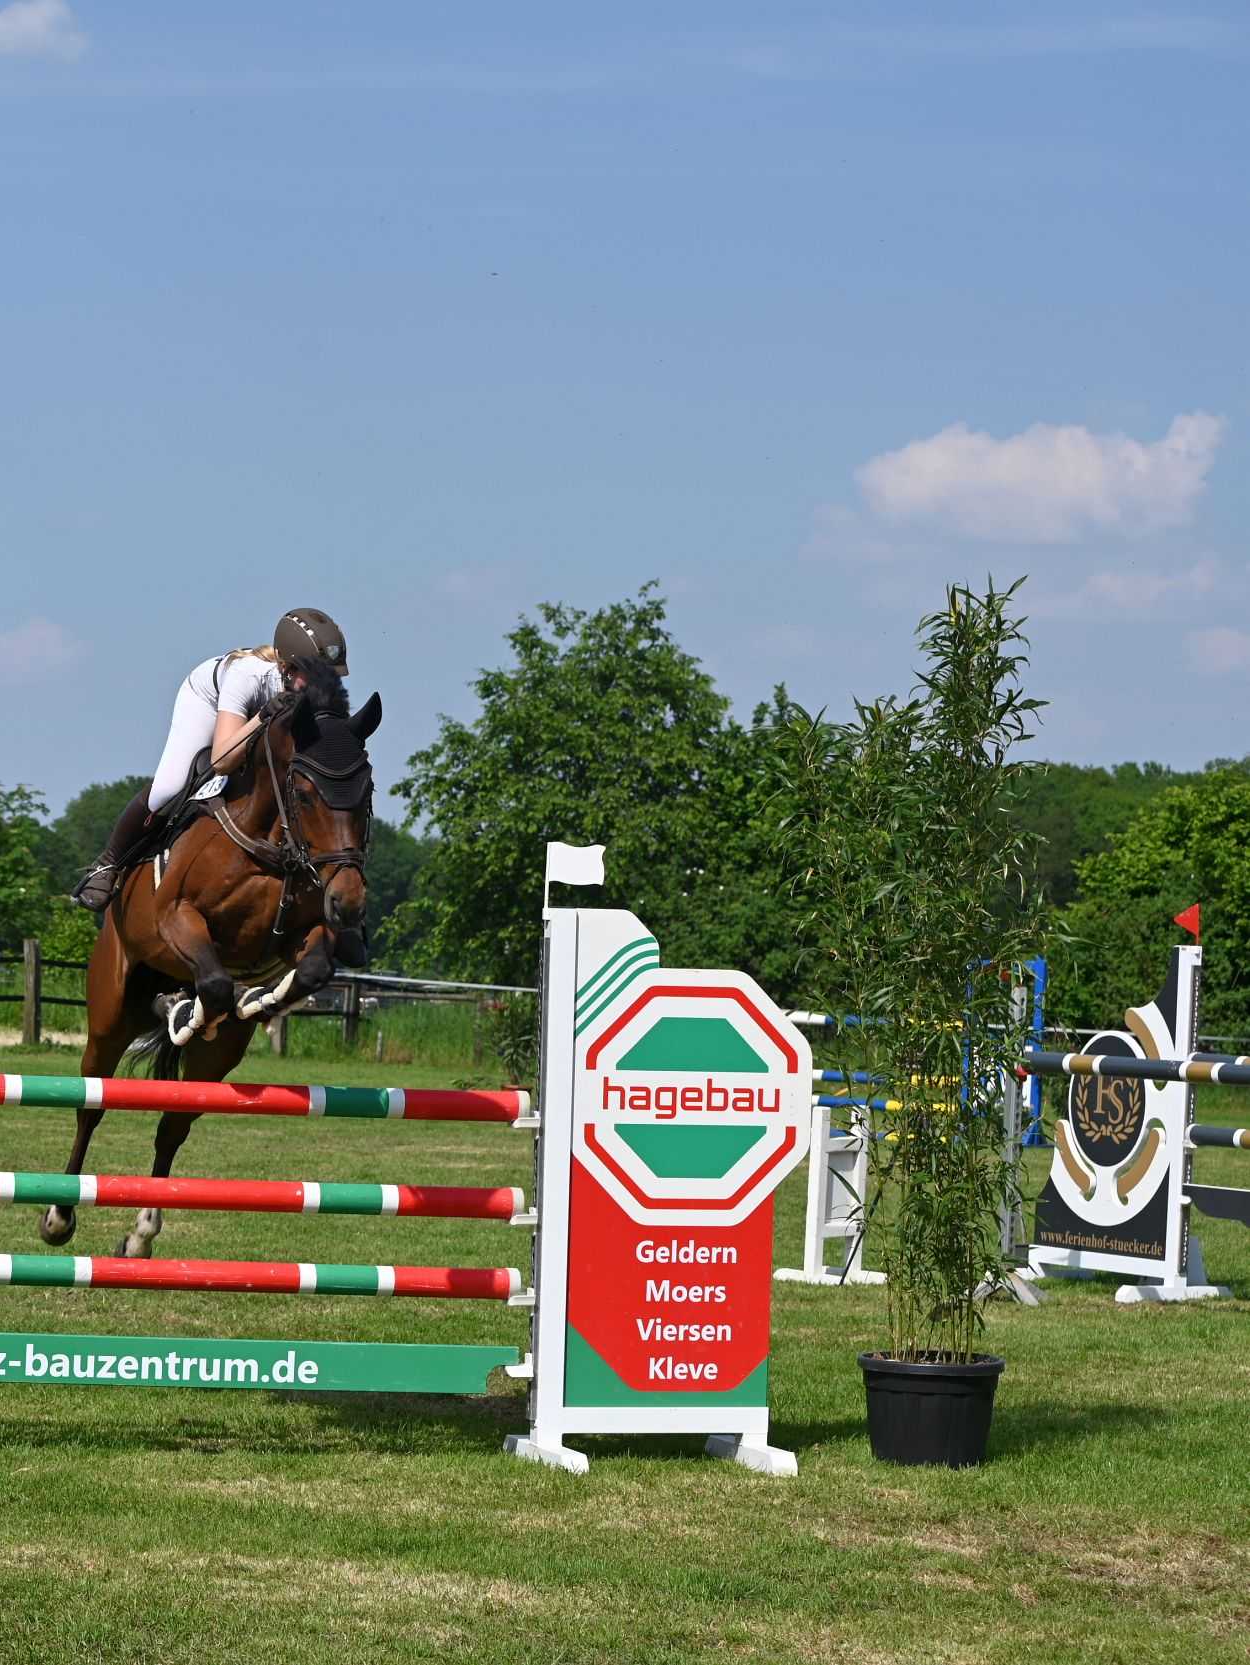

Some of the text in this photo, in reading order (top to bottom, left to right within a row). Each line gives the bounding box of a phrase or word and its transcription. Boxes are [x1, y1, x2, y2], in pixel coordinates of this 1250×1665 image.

[602, 1076, 781, 1120] hagebau
[635, 1239, 738, 1264] Geldern
[1039, 1230, 1163, 1256] www.ferienhof-stuecker.de
[645, 1279, 727, 1303] Moers
[636, 1318, 732, 1342] Viersen
[649, 1356, 719, 1380] Kleve
